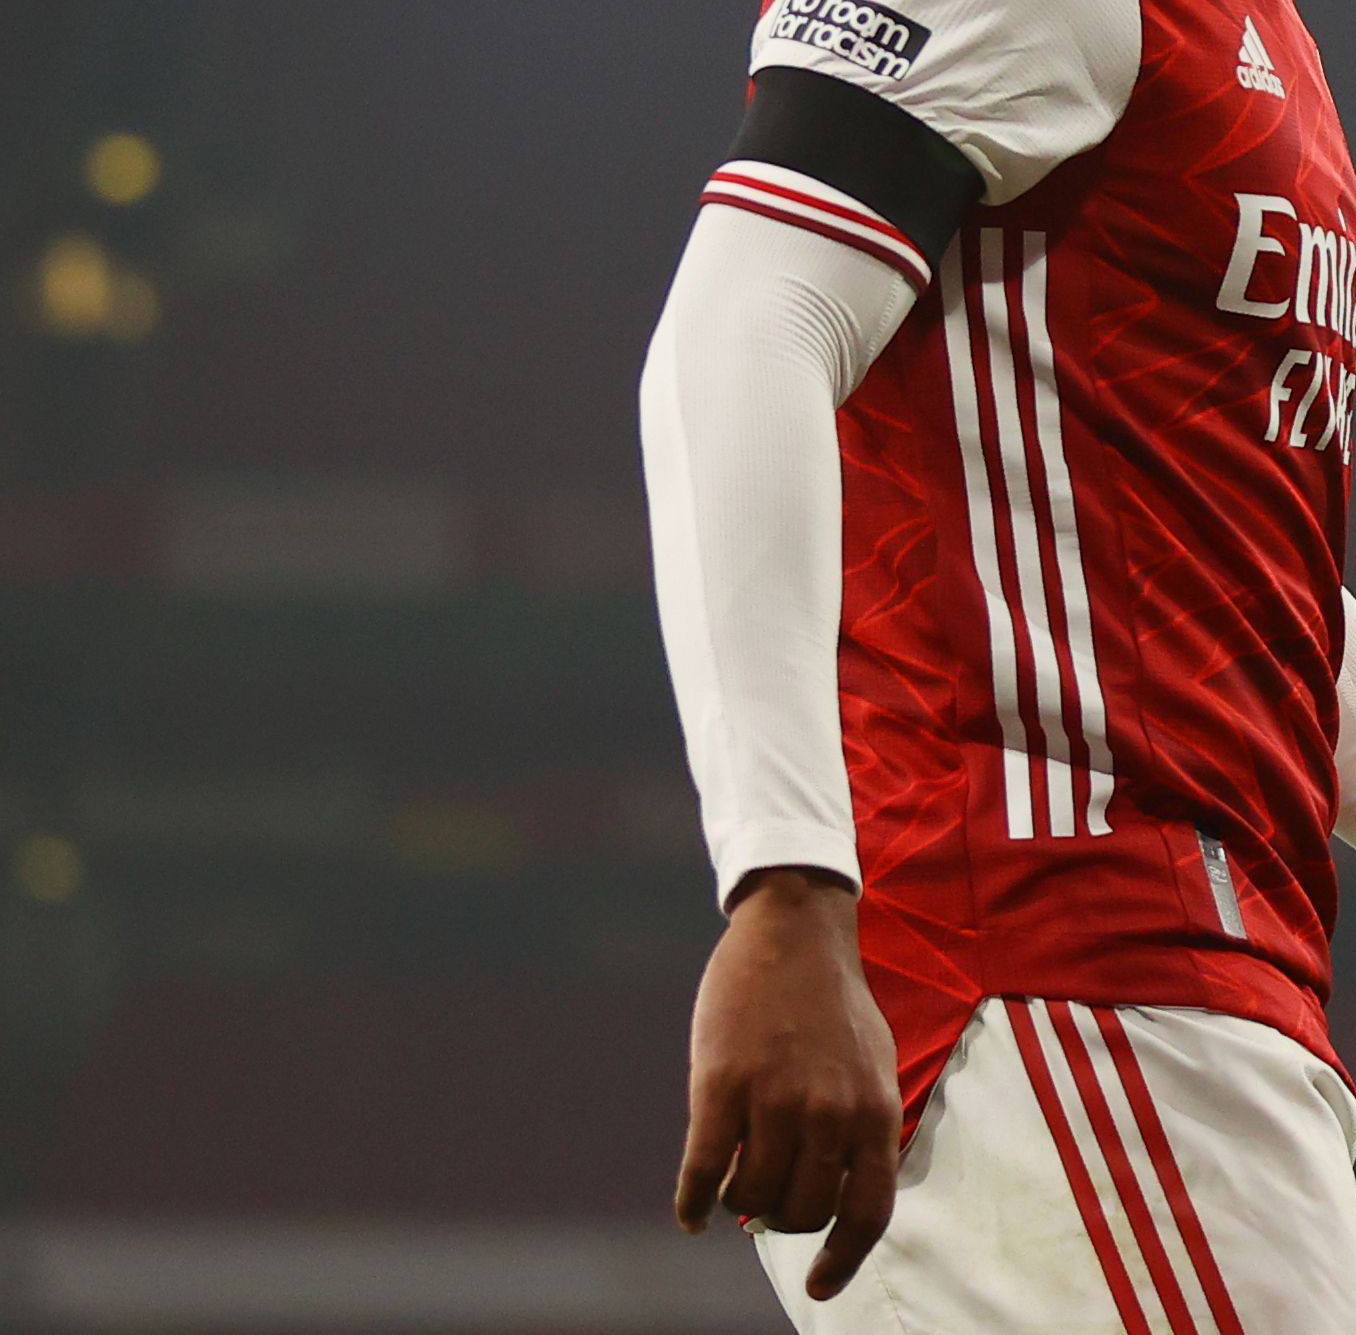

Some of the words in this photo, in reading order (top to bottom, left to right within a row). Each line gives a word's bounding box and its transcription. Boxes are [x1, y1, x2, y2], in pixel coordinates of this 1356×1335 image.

[771, 11, 809, 39] for
[802, 20, 911, 80] racism
[1236, 65, 1286, 99] adidas
